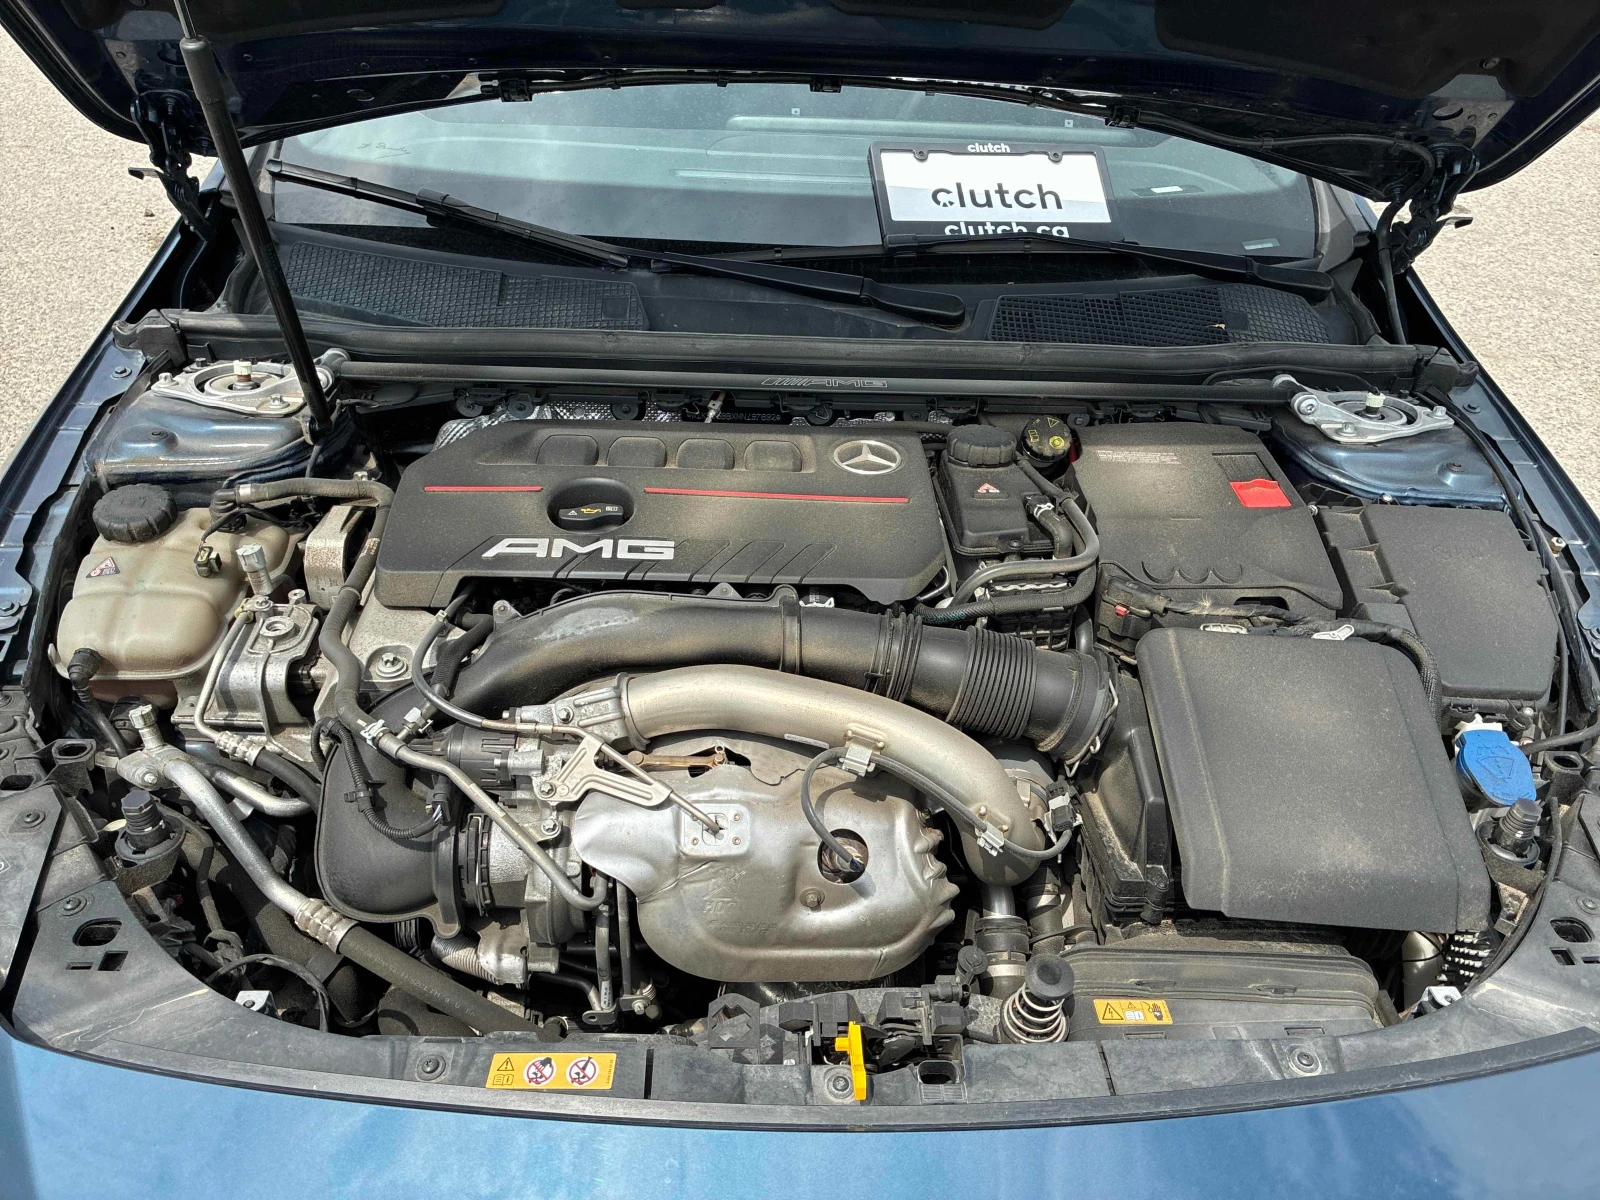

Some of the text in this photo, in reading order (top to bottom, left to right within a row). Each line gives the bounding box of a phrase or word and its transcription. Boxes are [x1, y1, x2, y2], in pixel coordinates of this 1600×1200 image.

[967, 143, 1011, 153] clutch
[931, 182, 1063, 210] clutch
[944, 221, 1070, 238] clutchca
[481, 537, 675, 560] AMG
